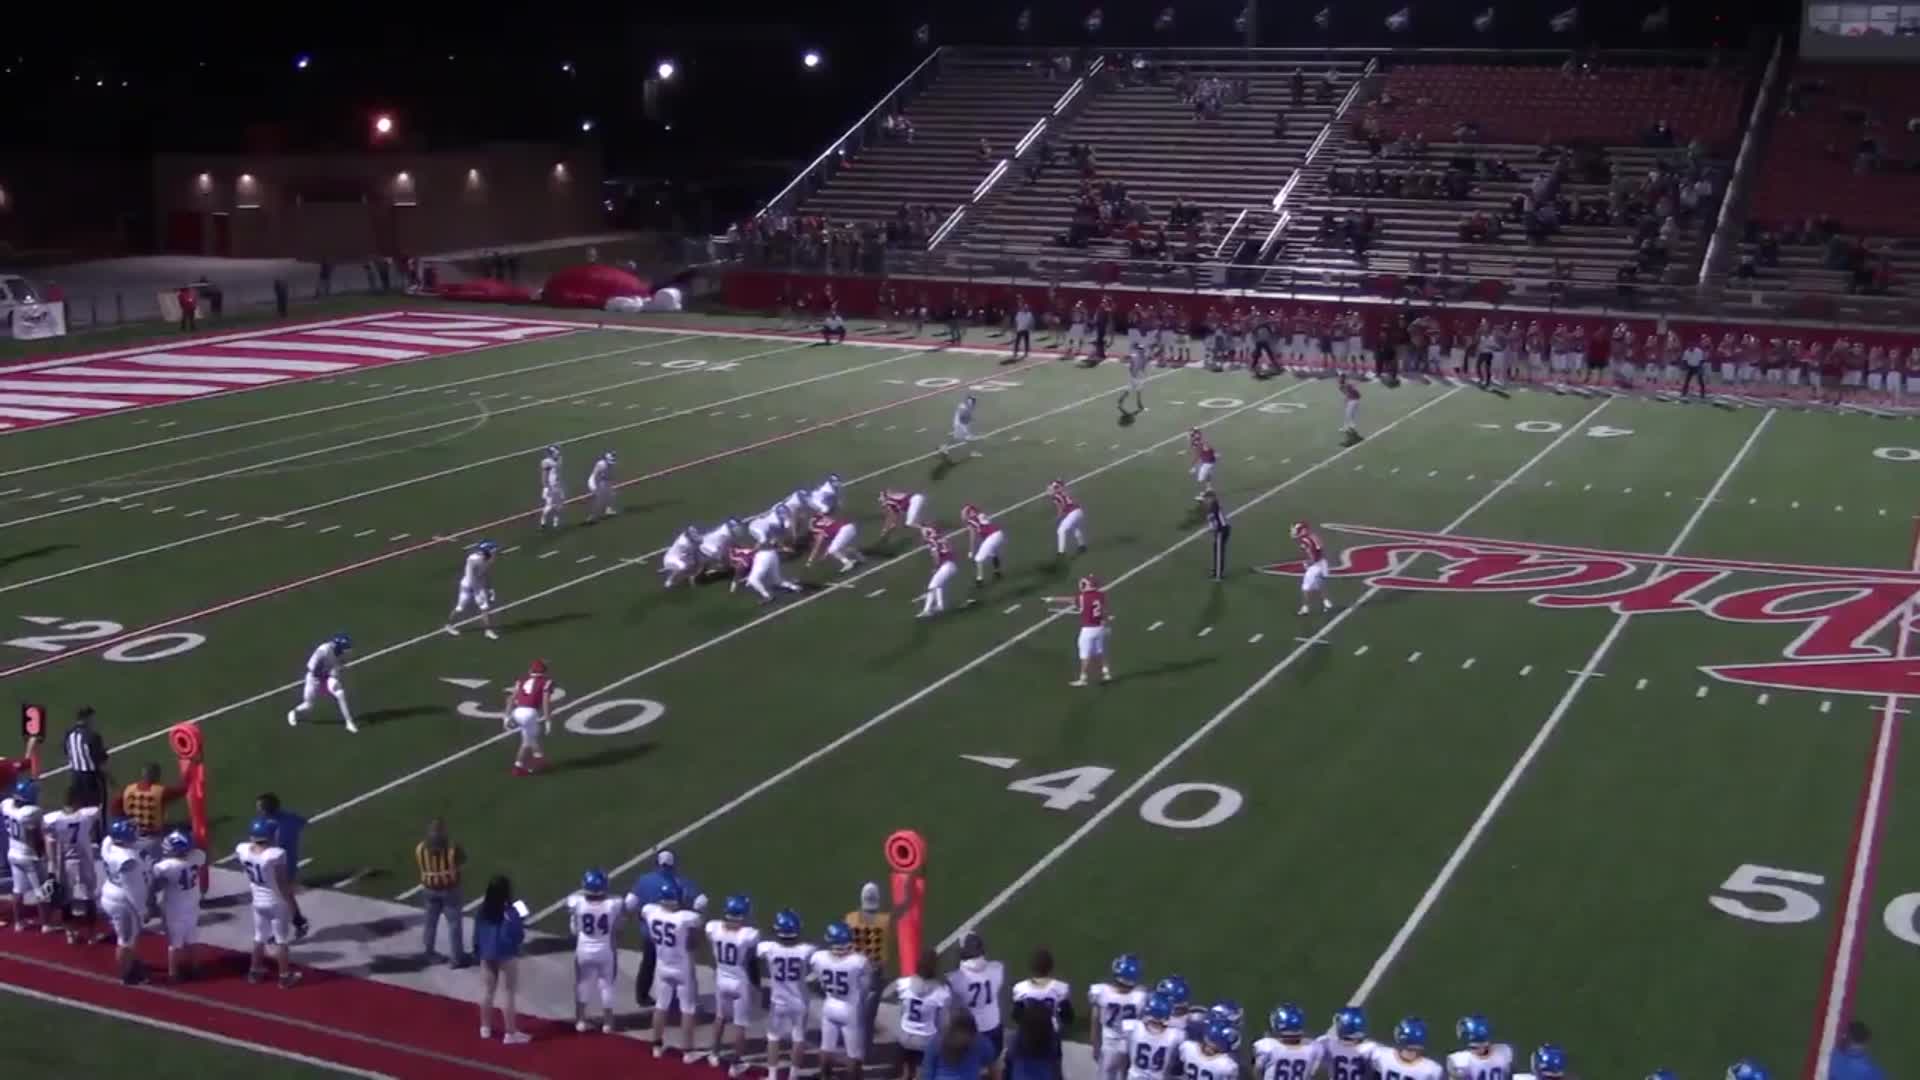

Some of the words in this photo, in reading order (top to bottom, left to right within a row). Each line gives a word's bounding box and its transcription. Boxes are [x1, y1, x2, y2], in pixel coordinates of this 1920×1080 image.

[1513, 420, 1635, 438] 40
[1260, 530, 1920, 697] bras
[2, 620, 207, 662] 20
[522, 677, 537, 695] 4
[25, 706, 42, 735] 3
[1006, 765, 1244, 829] 40
[67, 822, 80, 844] 7
[581, 913, 609, 936] 84
[652, 919, 677, 947] 55
[716, 940, 737, 966] 10
[773, 957, 801, 982] 35
[822, 969, 849, 996] 25
[967, 979, 992, 1008] 71
[908, 999, 923, 1023] 5
[1106, 1002, 1137, 1029] 72
[1135, 1042, 1168, 1073] 64
[1275, 1058, 1306, 1080] 68
